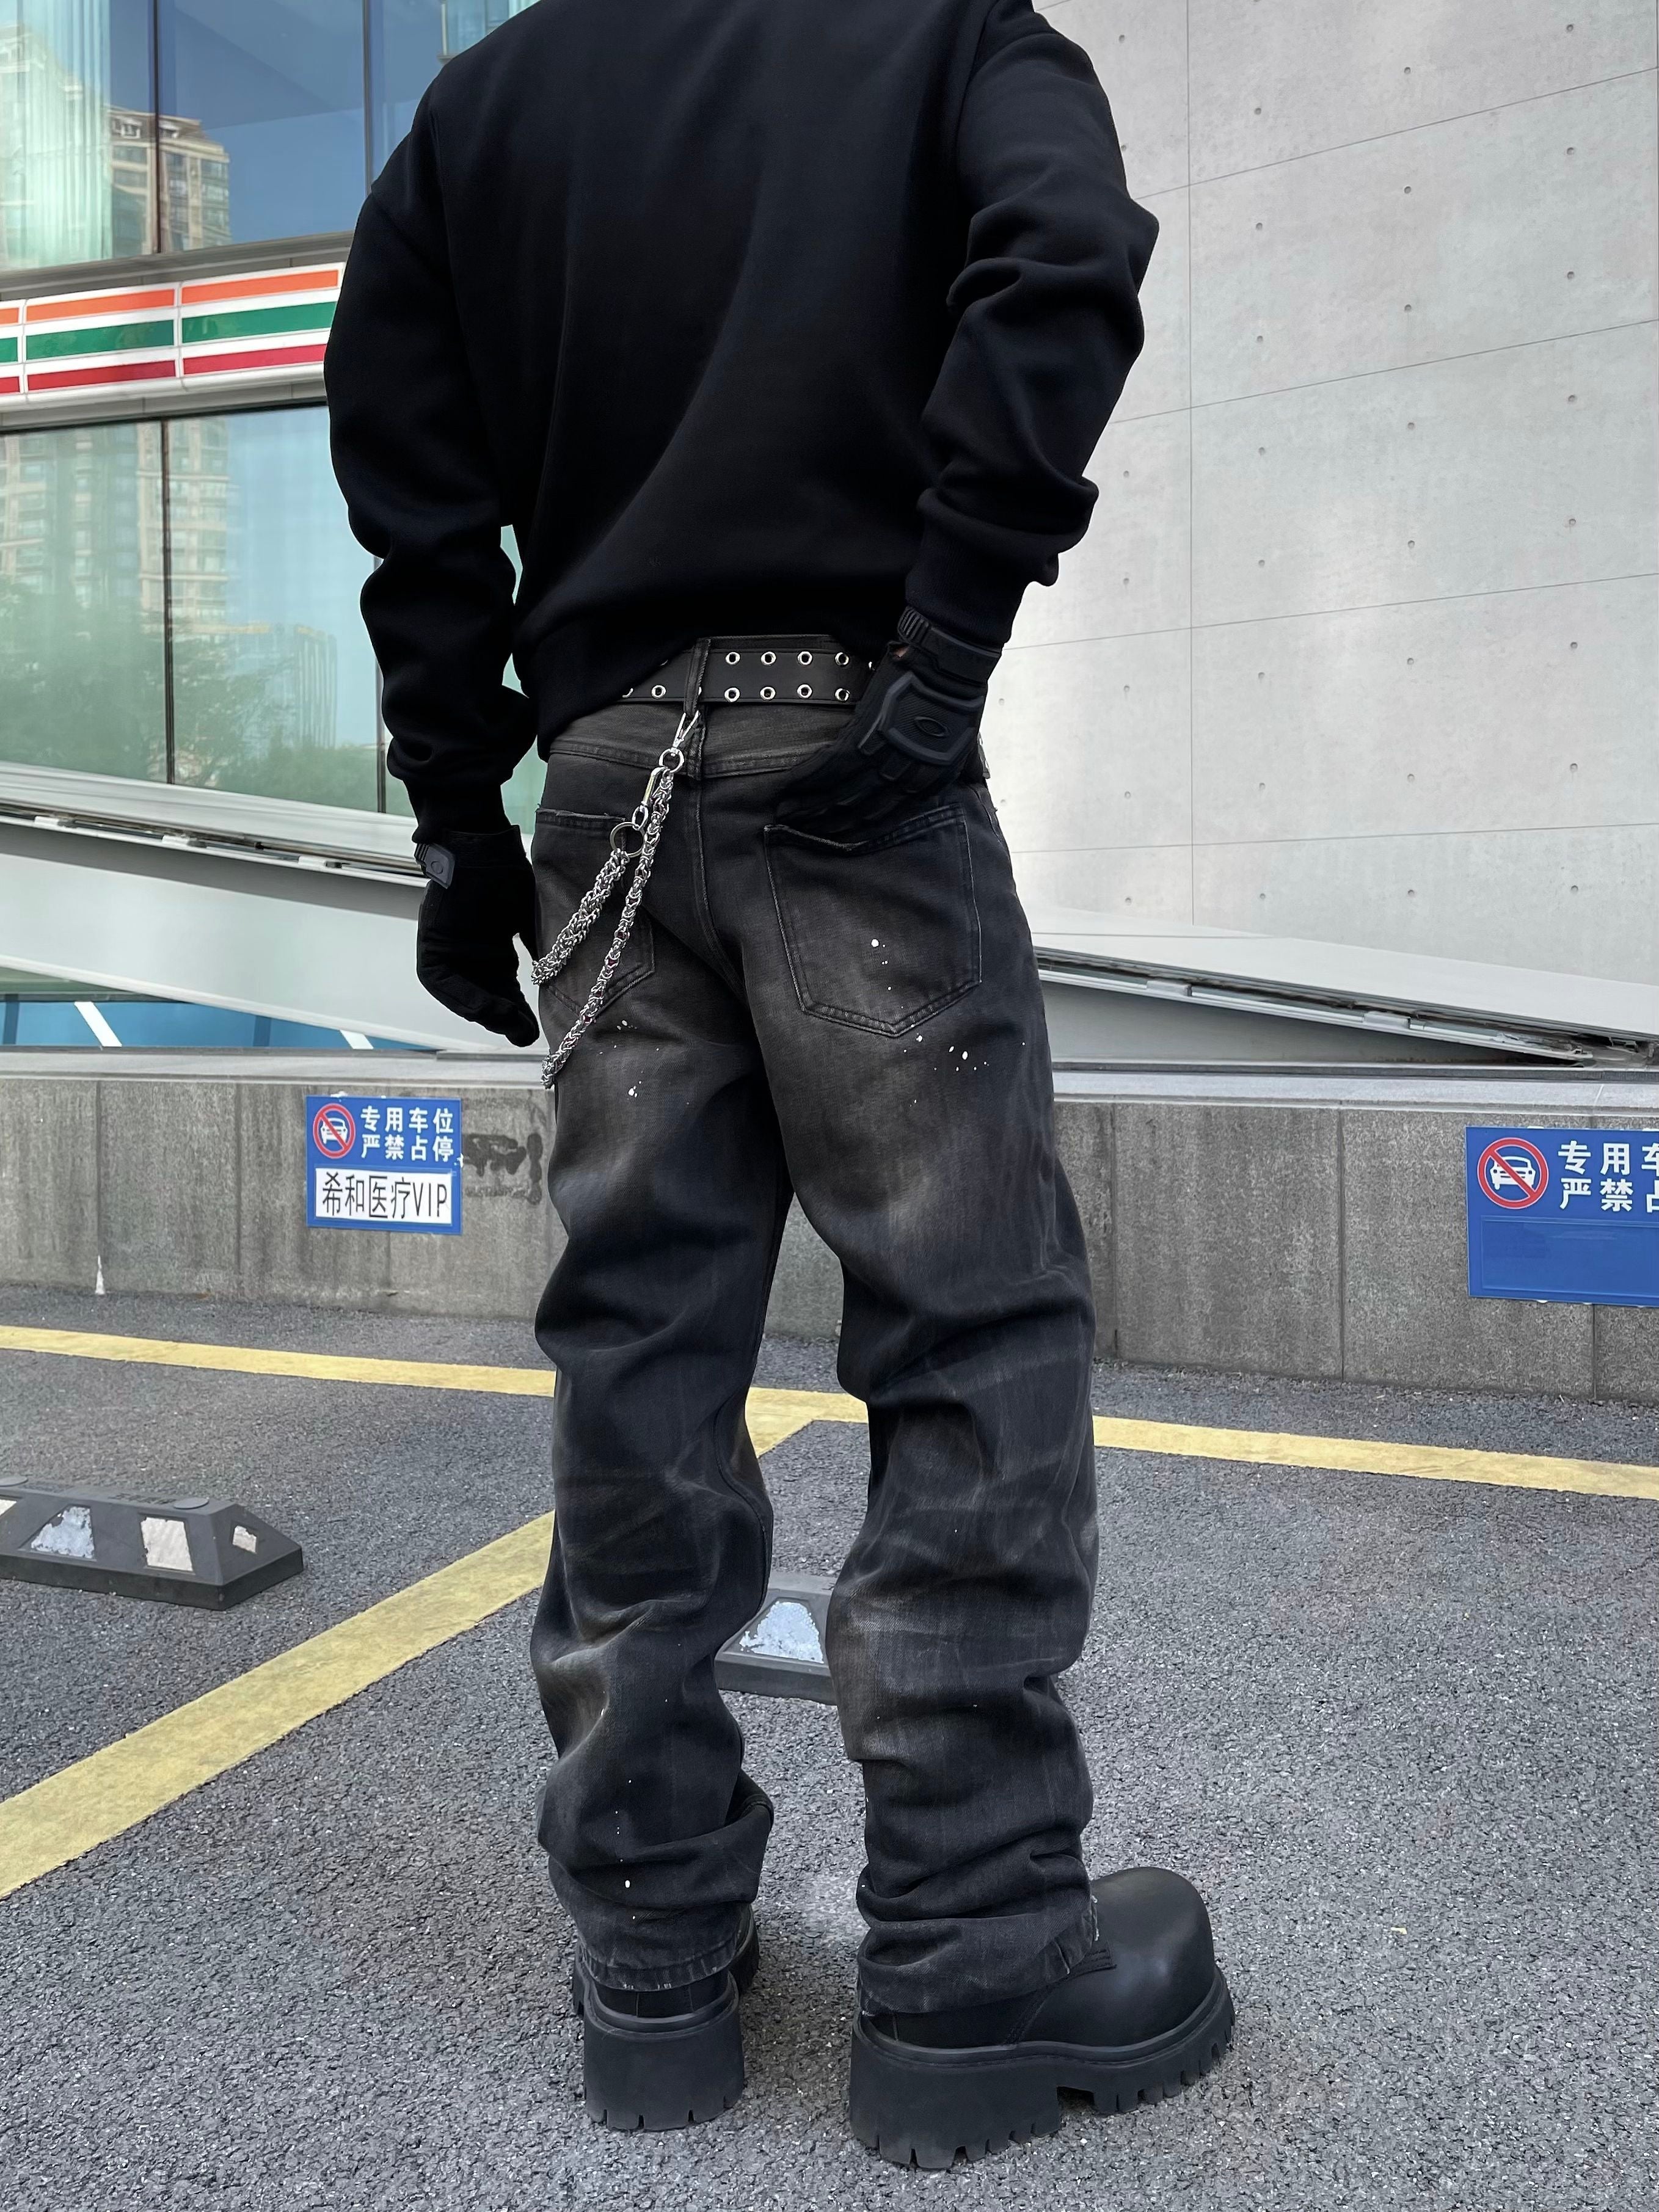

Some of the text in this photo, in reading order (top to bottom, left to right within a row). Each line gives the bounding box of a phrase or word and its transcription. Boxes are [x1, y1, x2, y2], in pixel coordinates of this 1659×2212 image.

[360, 1105, 454, 1134] 专用车位
[361, 1134, 454, 1162] 严禁占停
[323, 1171, 447, 1218] 希和医疗VIP
